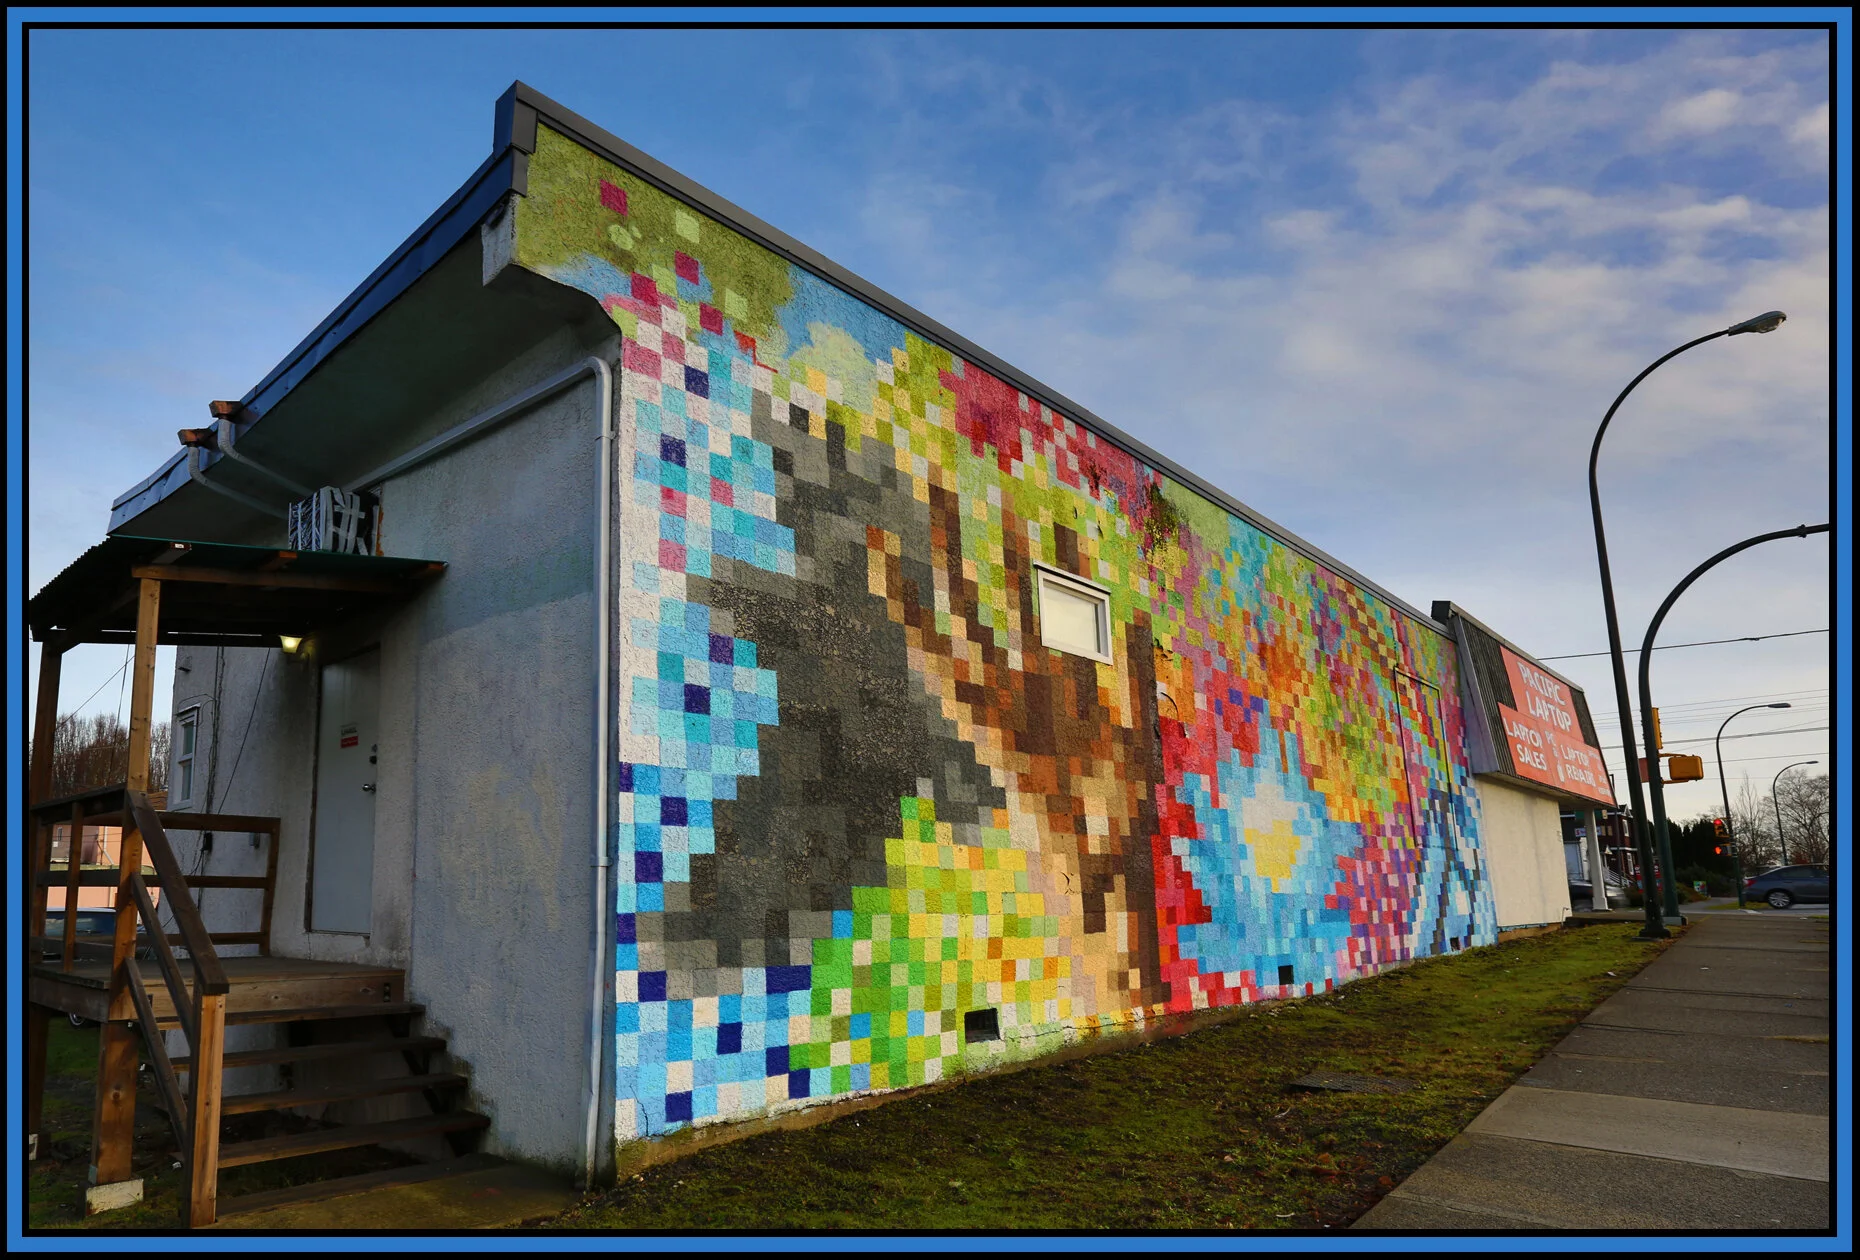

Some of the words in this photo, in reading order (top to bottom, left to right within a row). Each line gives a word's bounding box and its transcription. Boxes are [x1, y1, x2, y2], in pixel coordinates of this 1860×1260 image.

[1517, 661, 1565, 706] PACIFIC
[1526, 691, 1572, 732] LAPTOP
[1503, 717, 1543, 749] LAPTOP
[1516, 743, 1547, 770] SALES
[1560, 744, 1590, 767] LAPTOP
